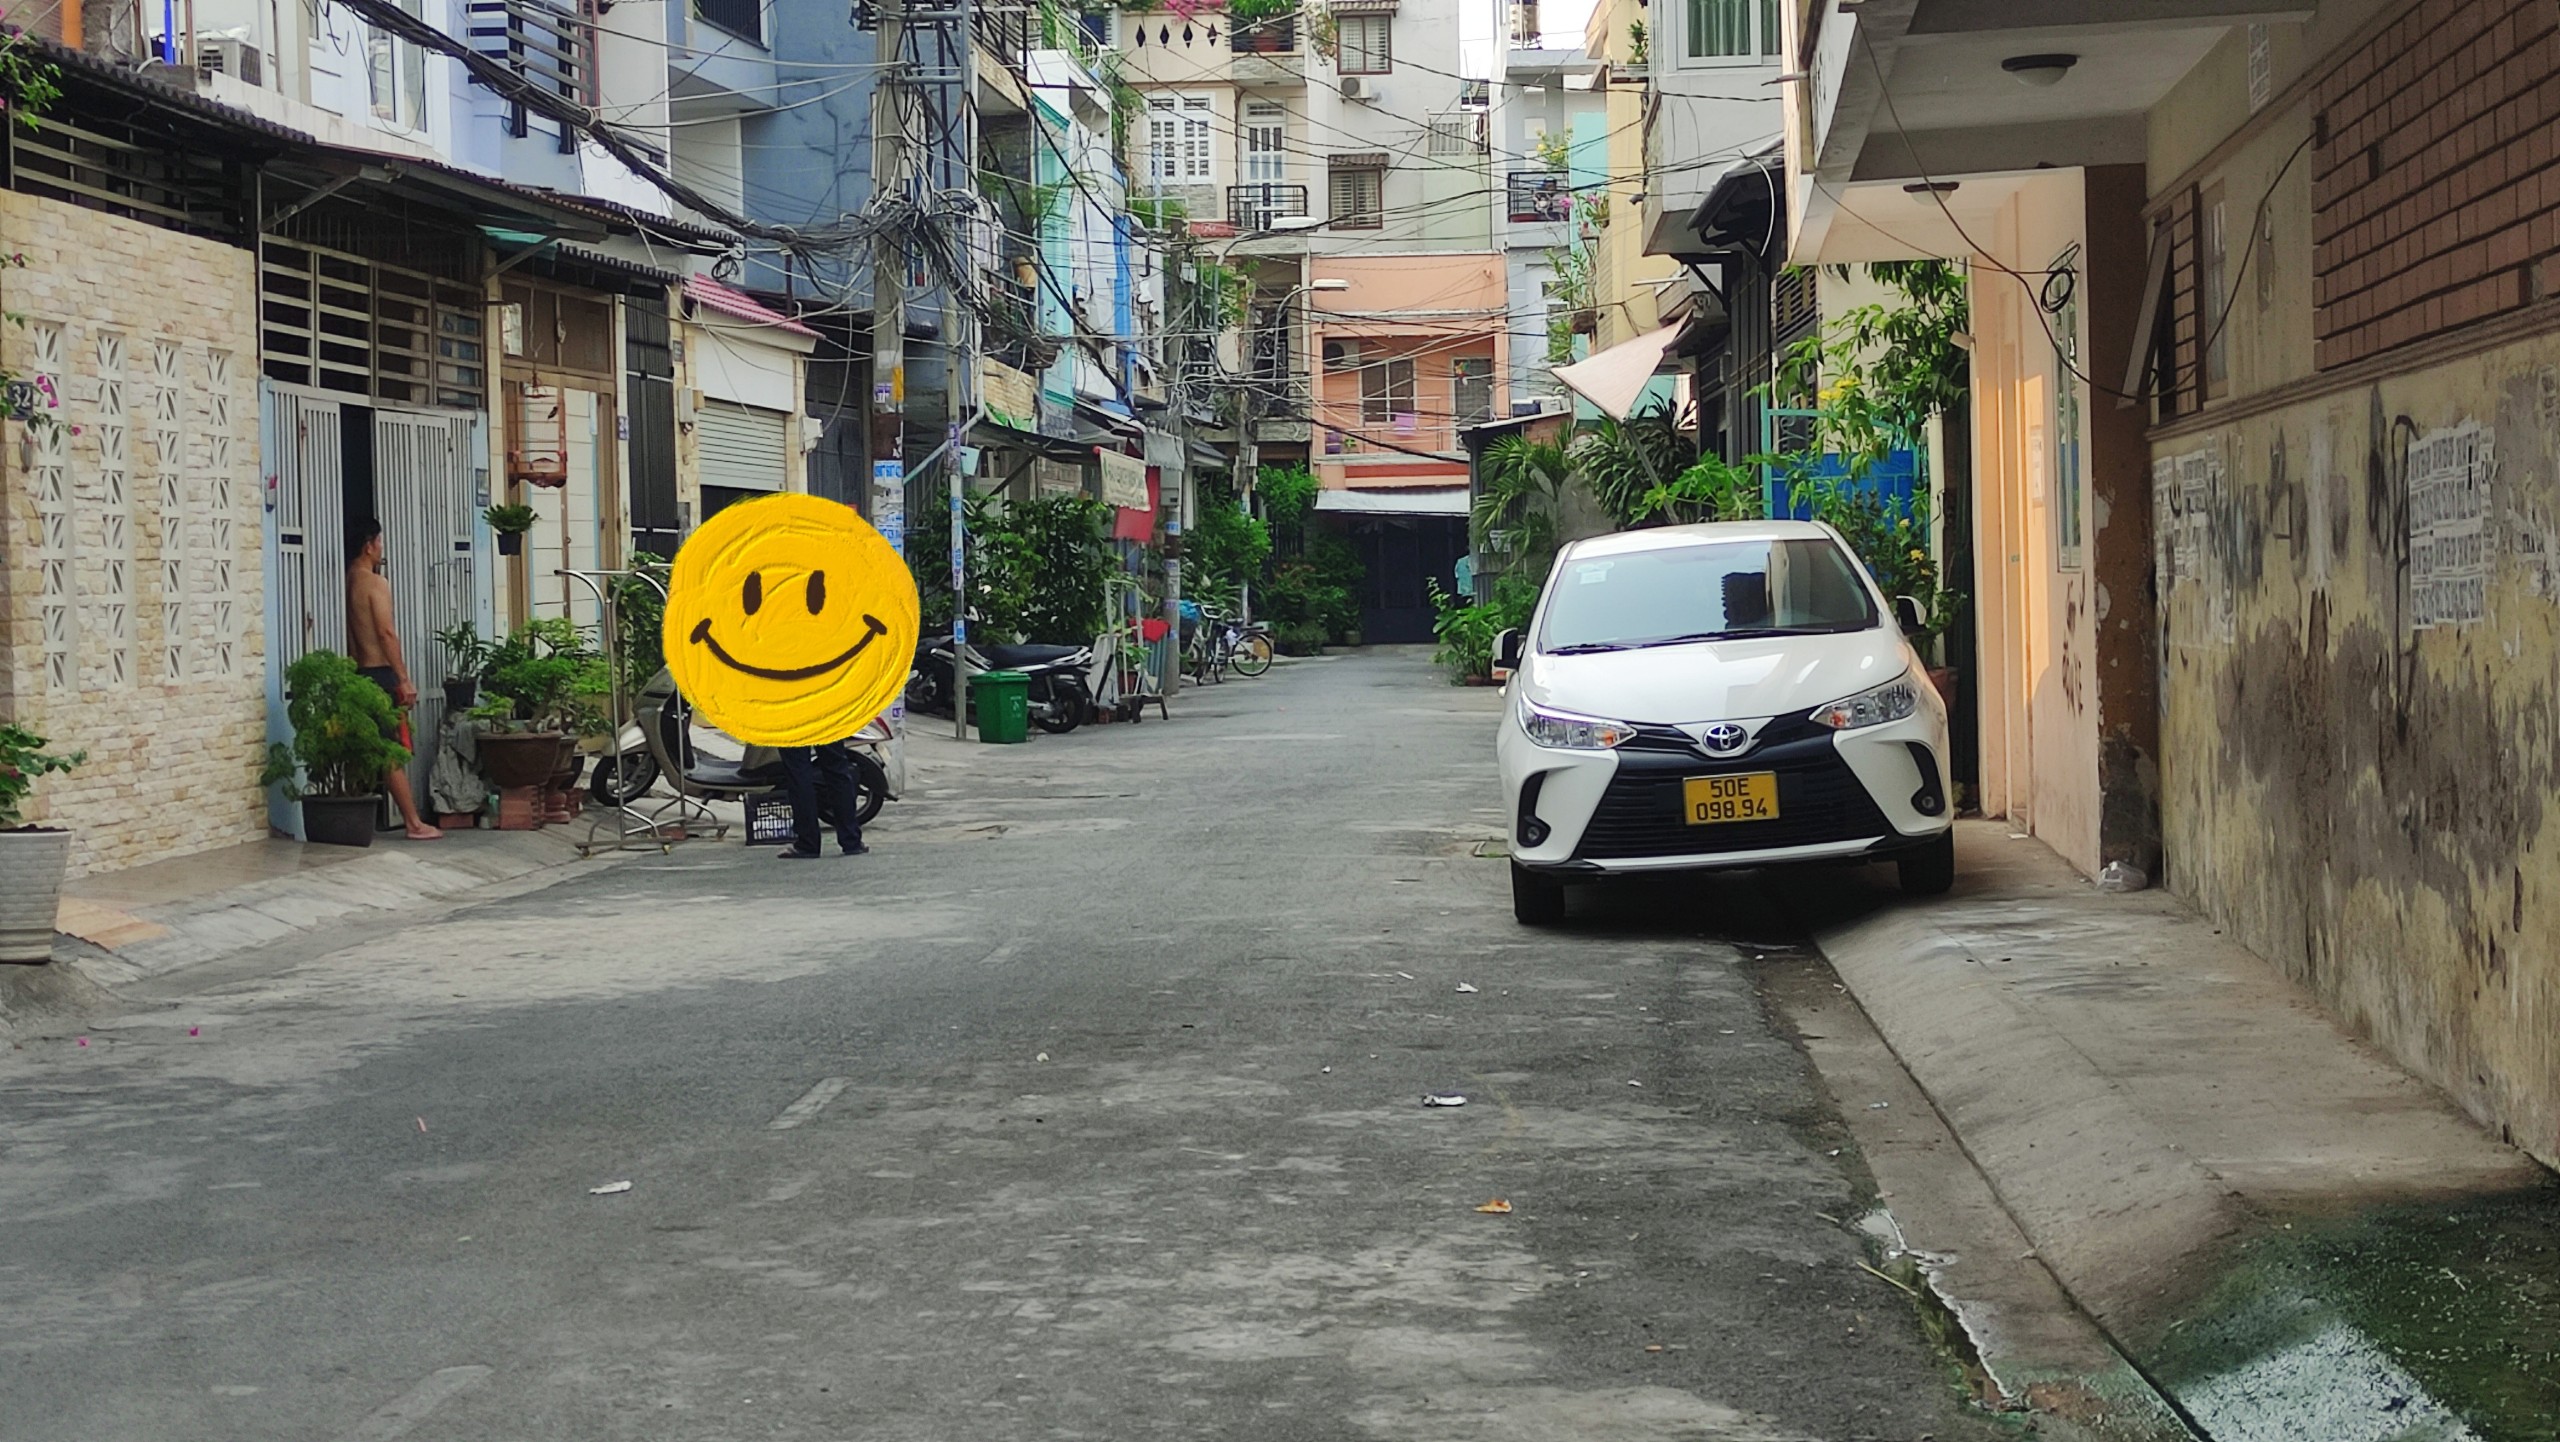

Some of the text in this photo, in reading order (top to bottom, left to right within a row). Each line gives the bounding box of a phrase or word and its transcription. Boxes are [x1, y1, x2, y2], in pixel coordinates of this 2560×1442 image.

[12, 384, 32, 408] 32
[1710, 777, 1750, 798] 50E
[1696, 797, 1768, 821] 098.94
